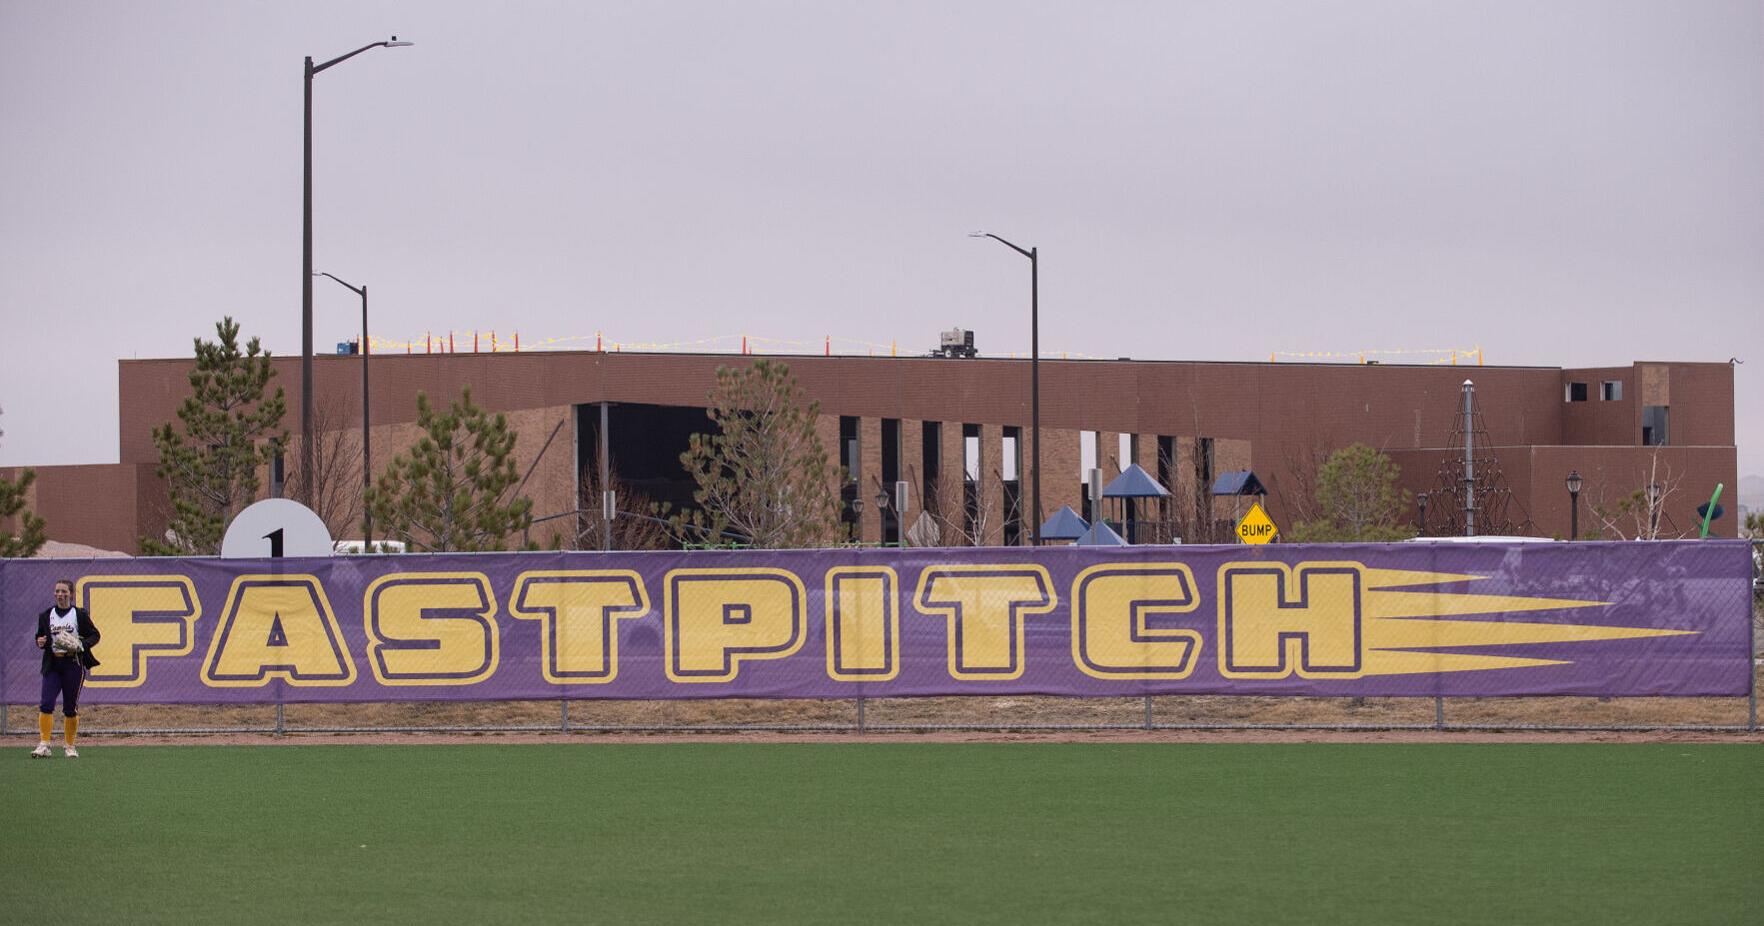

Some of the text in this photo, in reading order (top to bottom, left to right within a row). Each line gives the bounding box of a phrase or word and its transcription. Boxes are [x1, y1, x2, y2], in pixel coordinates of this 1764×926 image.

[262, 528, 284, 558] 1
[1241, 524, 1272, 536] BUMP
[76, 561, 1368, 688] FASTPITCH
